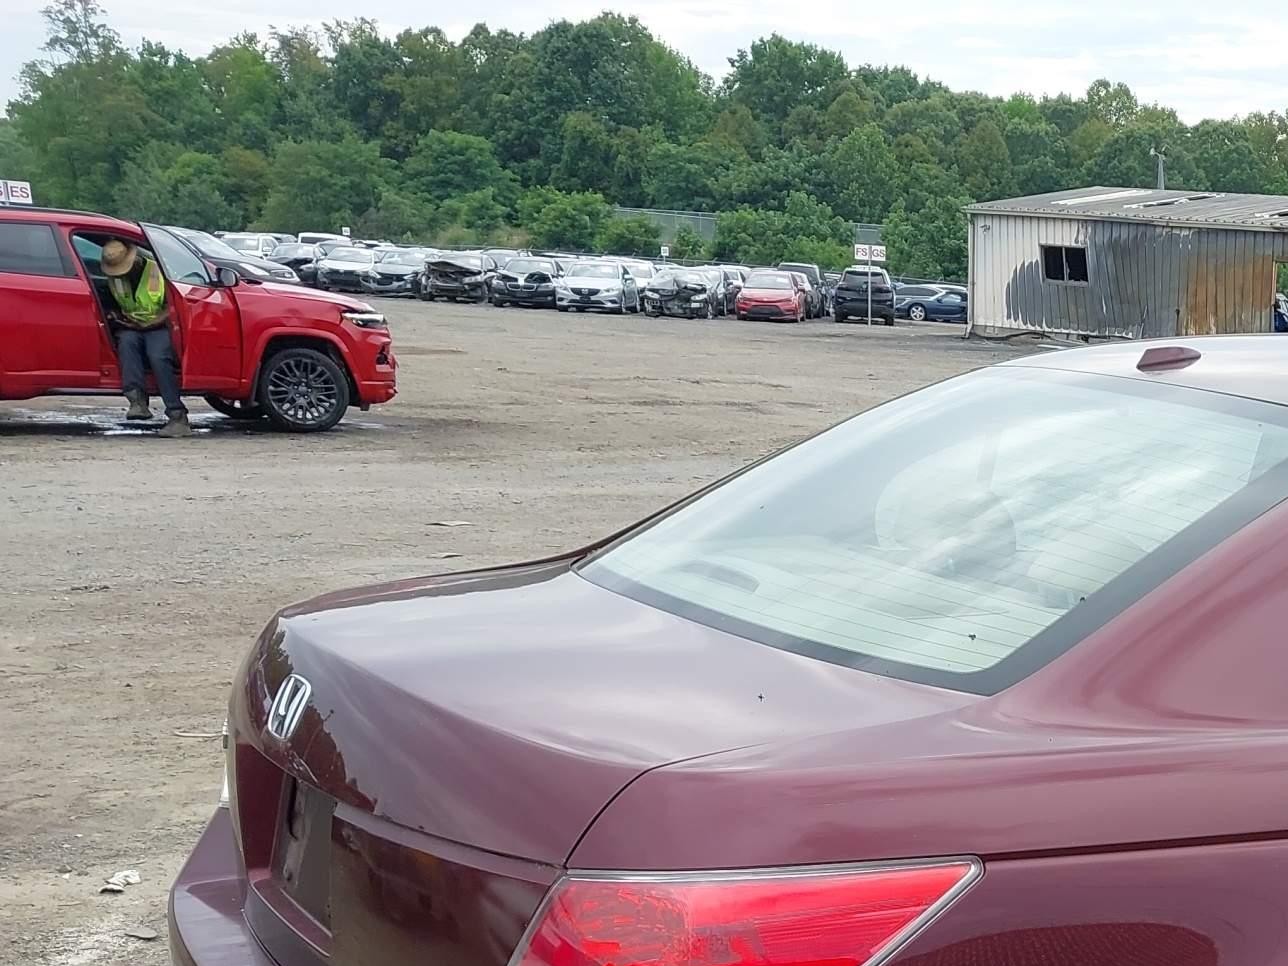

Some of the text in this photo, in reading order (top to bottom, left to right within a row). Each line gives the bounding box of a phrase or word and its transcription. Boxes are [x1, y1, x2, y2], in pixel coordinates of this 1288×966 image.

[10, 185, 30, 199] ES
[856, 247, 886, 258] FS GS
